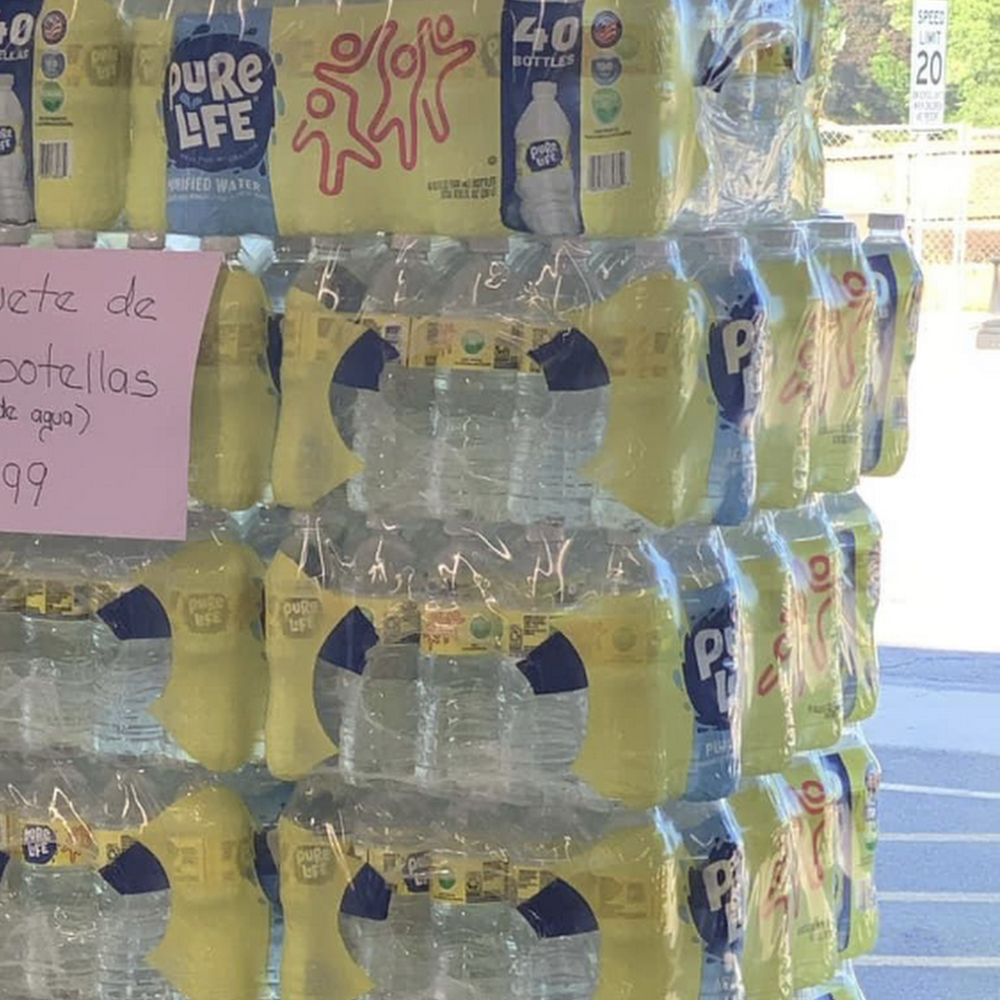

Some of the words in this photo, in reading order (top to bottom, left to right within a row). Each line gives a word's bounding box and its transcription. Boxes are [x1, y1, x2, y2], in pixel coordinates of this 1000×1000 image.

[513, 16, 579, 52] 40
[917, 10, 945, 25] SPEED
[512, 54, 575, 68] BOTTLES
[916, 50, 943, 85] 20
[107, 275, 157, 321] de
